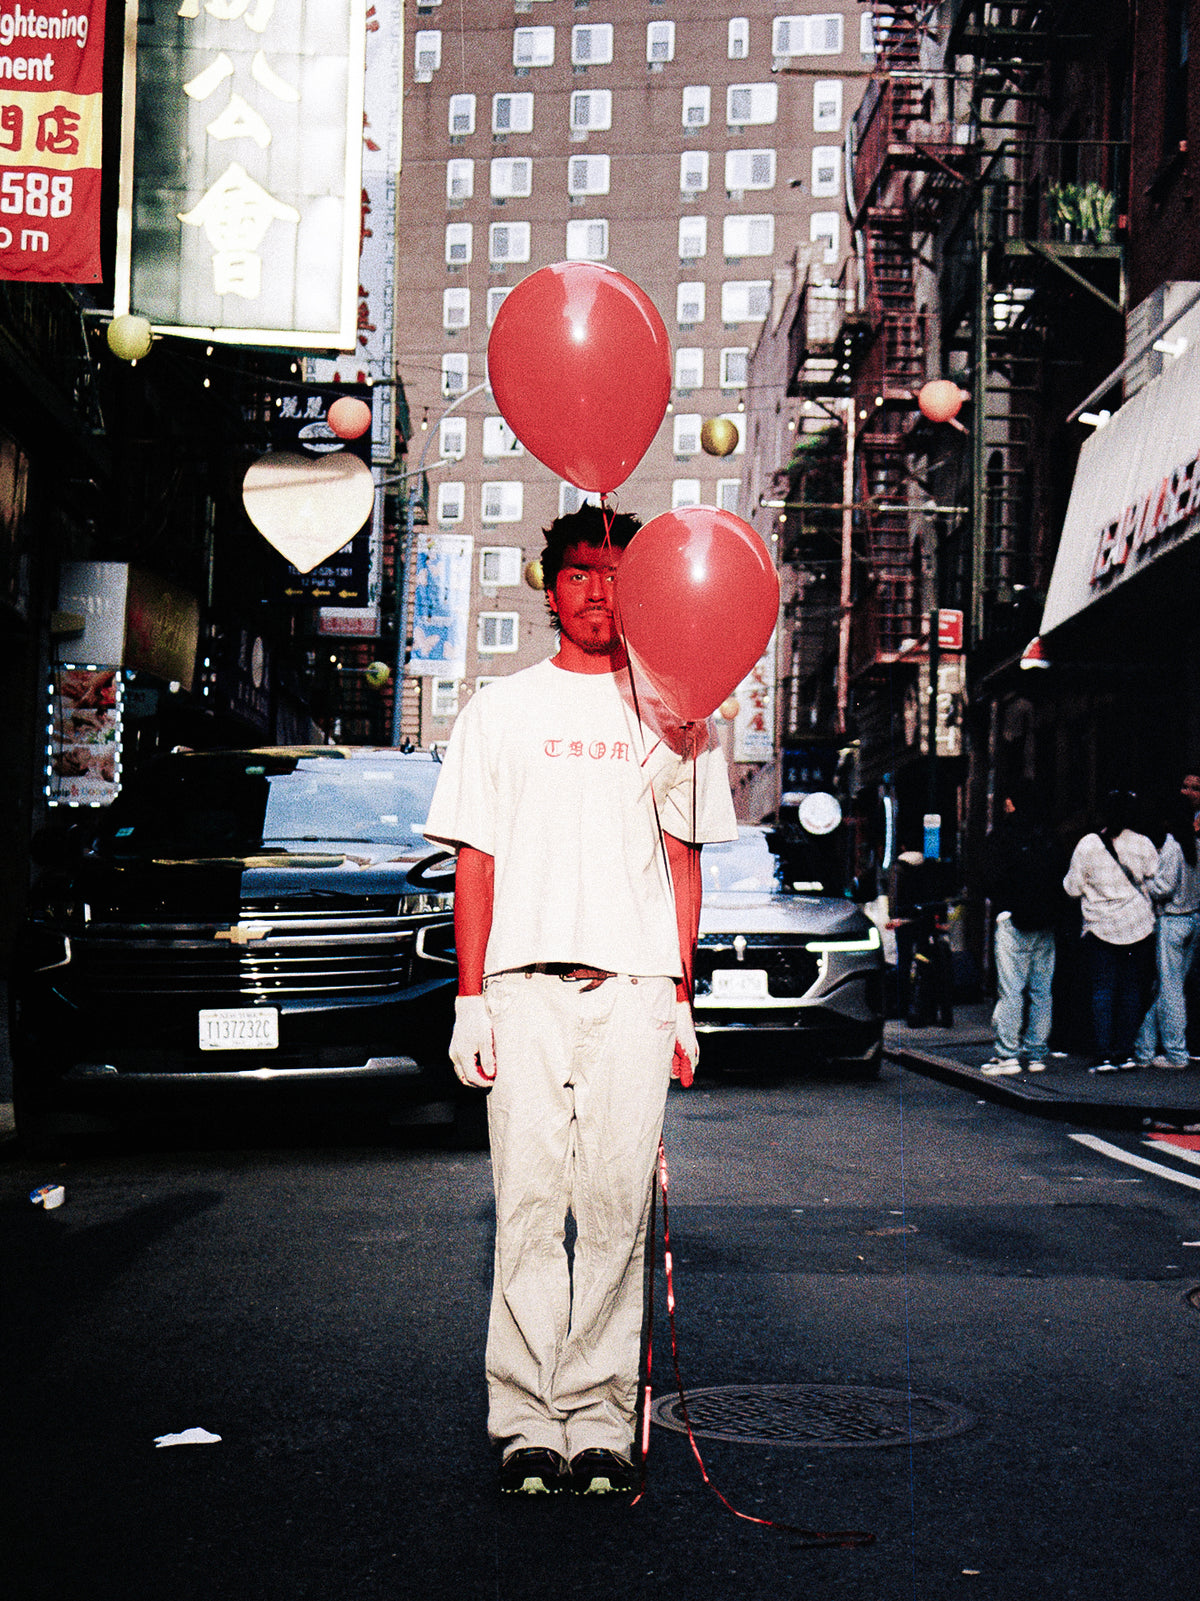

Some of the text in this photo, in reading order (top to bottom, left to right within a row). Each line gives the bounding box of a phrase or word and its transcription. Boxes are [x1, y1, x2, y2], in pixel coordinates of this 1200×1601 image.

[0, 3, 89, 48] ghtening
[0, 171, 73, 219] 588
[207, 1019, 270, 1039] T137232C
